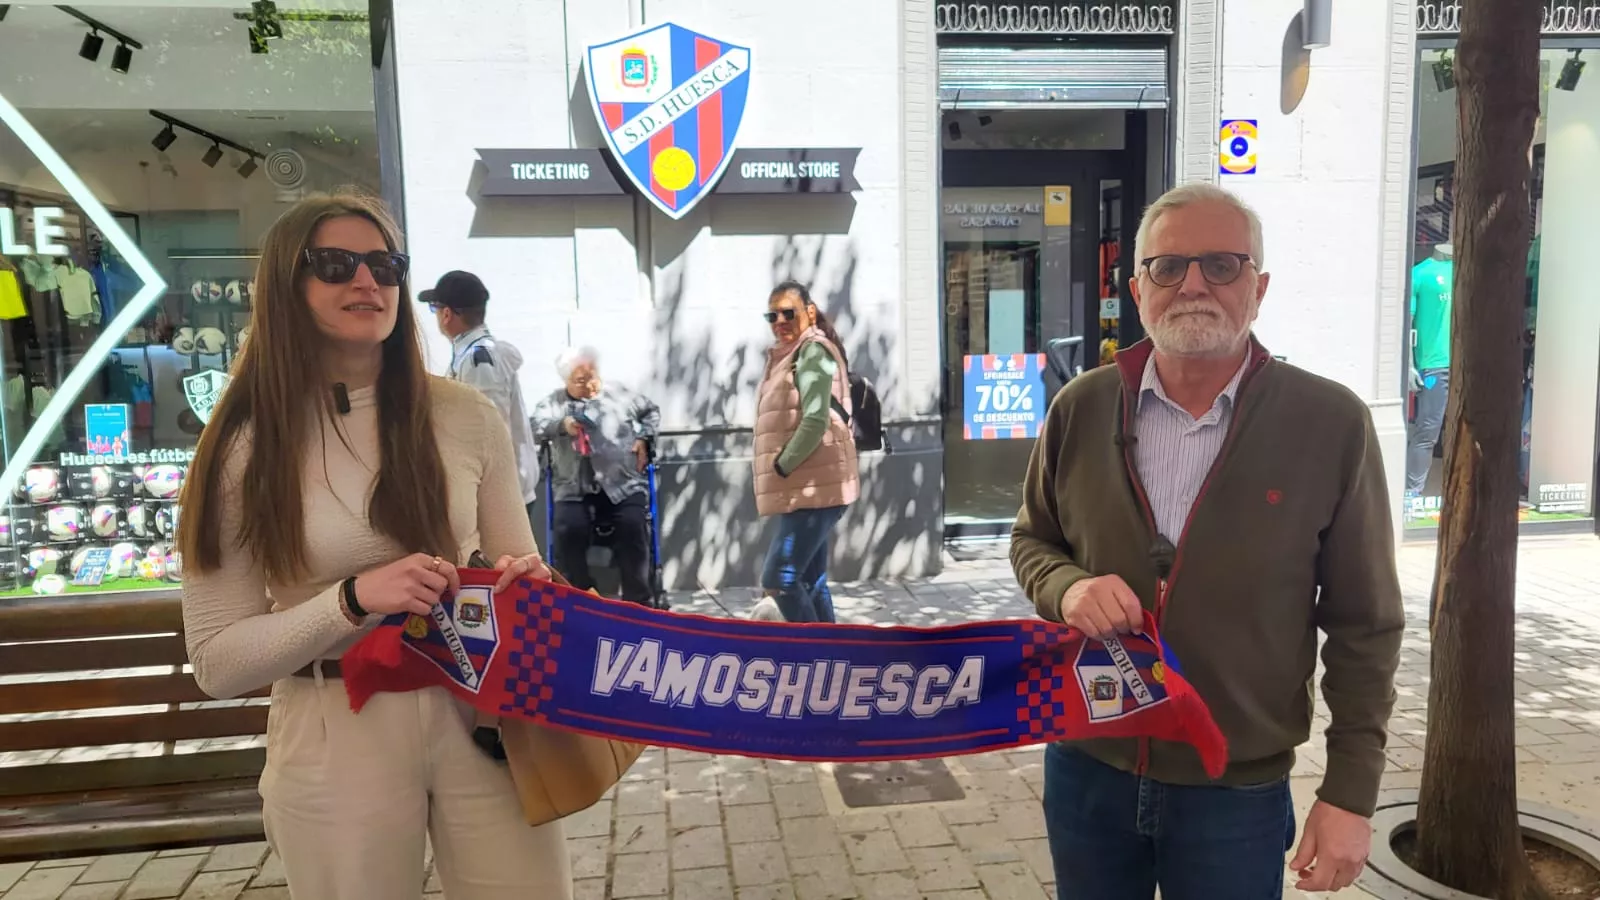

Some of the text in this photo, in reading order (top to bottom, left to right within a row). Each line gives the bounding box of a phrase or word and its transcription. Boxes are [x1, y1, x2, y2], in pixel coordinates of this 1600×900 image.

[624, 60, 740, 144] S.D. HUESCA
[511, 162, 590, 180] TICKETING
[741, 162, 840, 178] OFFICIAL STORE
[975, 384, 1033, 412] 70%
[973, 412, 1036, 423] DE DESCUENTO
[60, 447, 197, 466] Huesca es fútbo
[1539, 490, 1586, 500] TICKETING
[443, 627, 473, 680] HUESCA
[591, 637, 985, 720] VAMOSHUESCA
[1105, 637, 1149, 699] S.D. HUES
